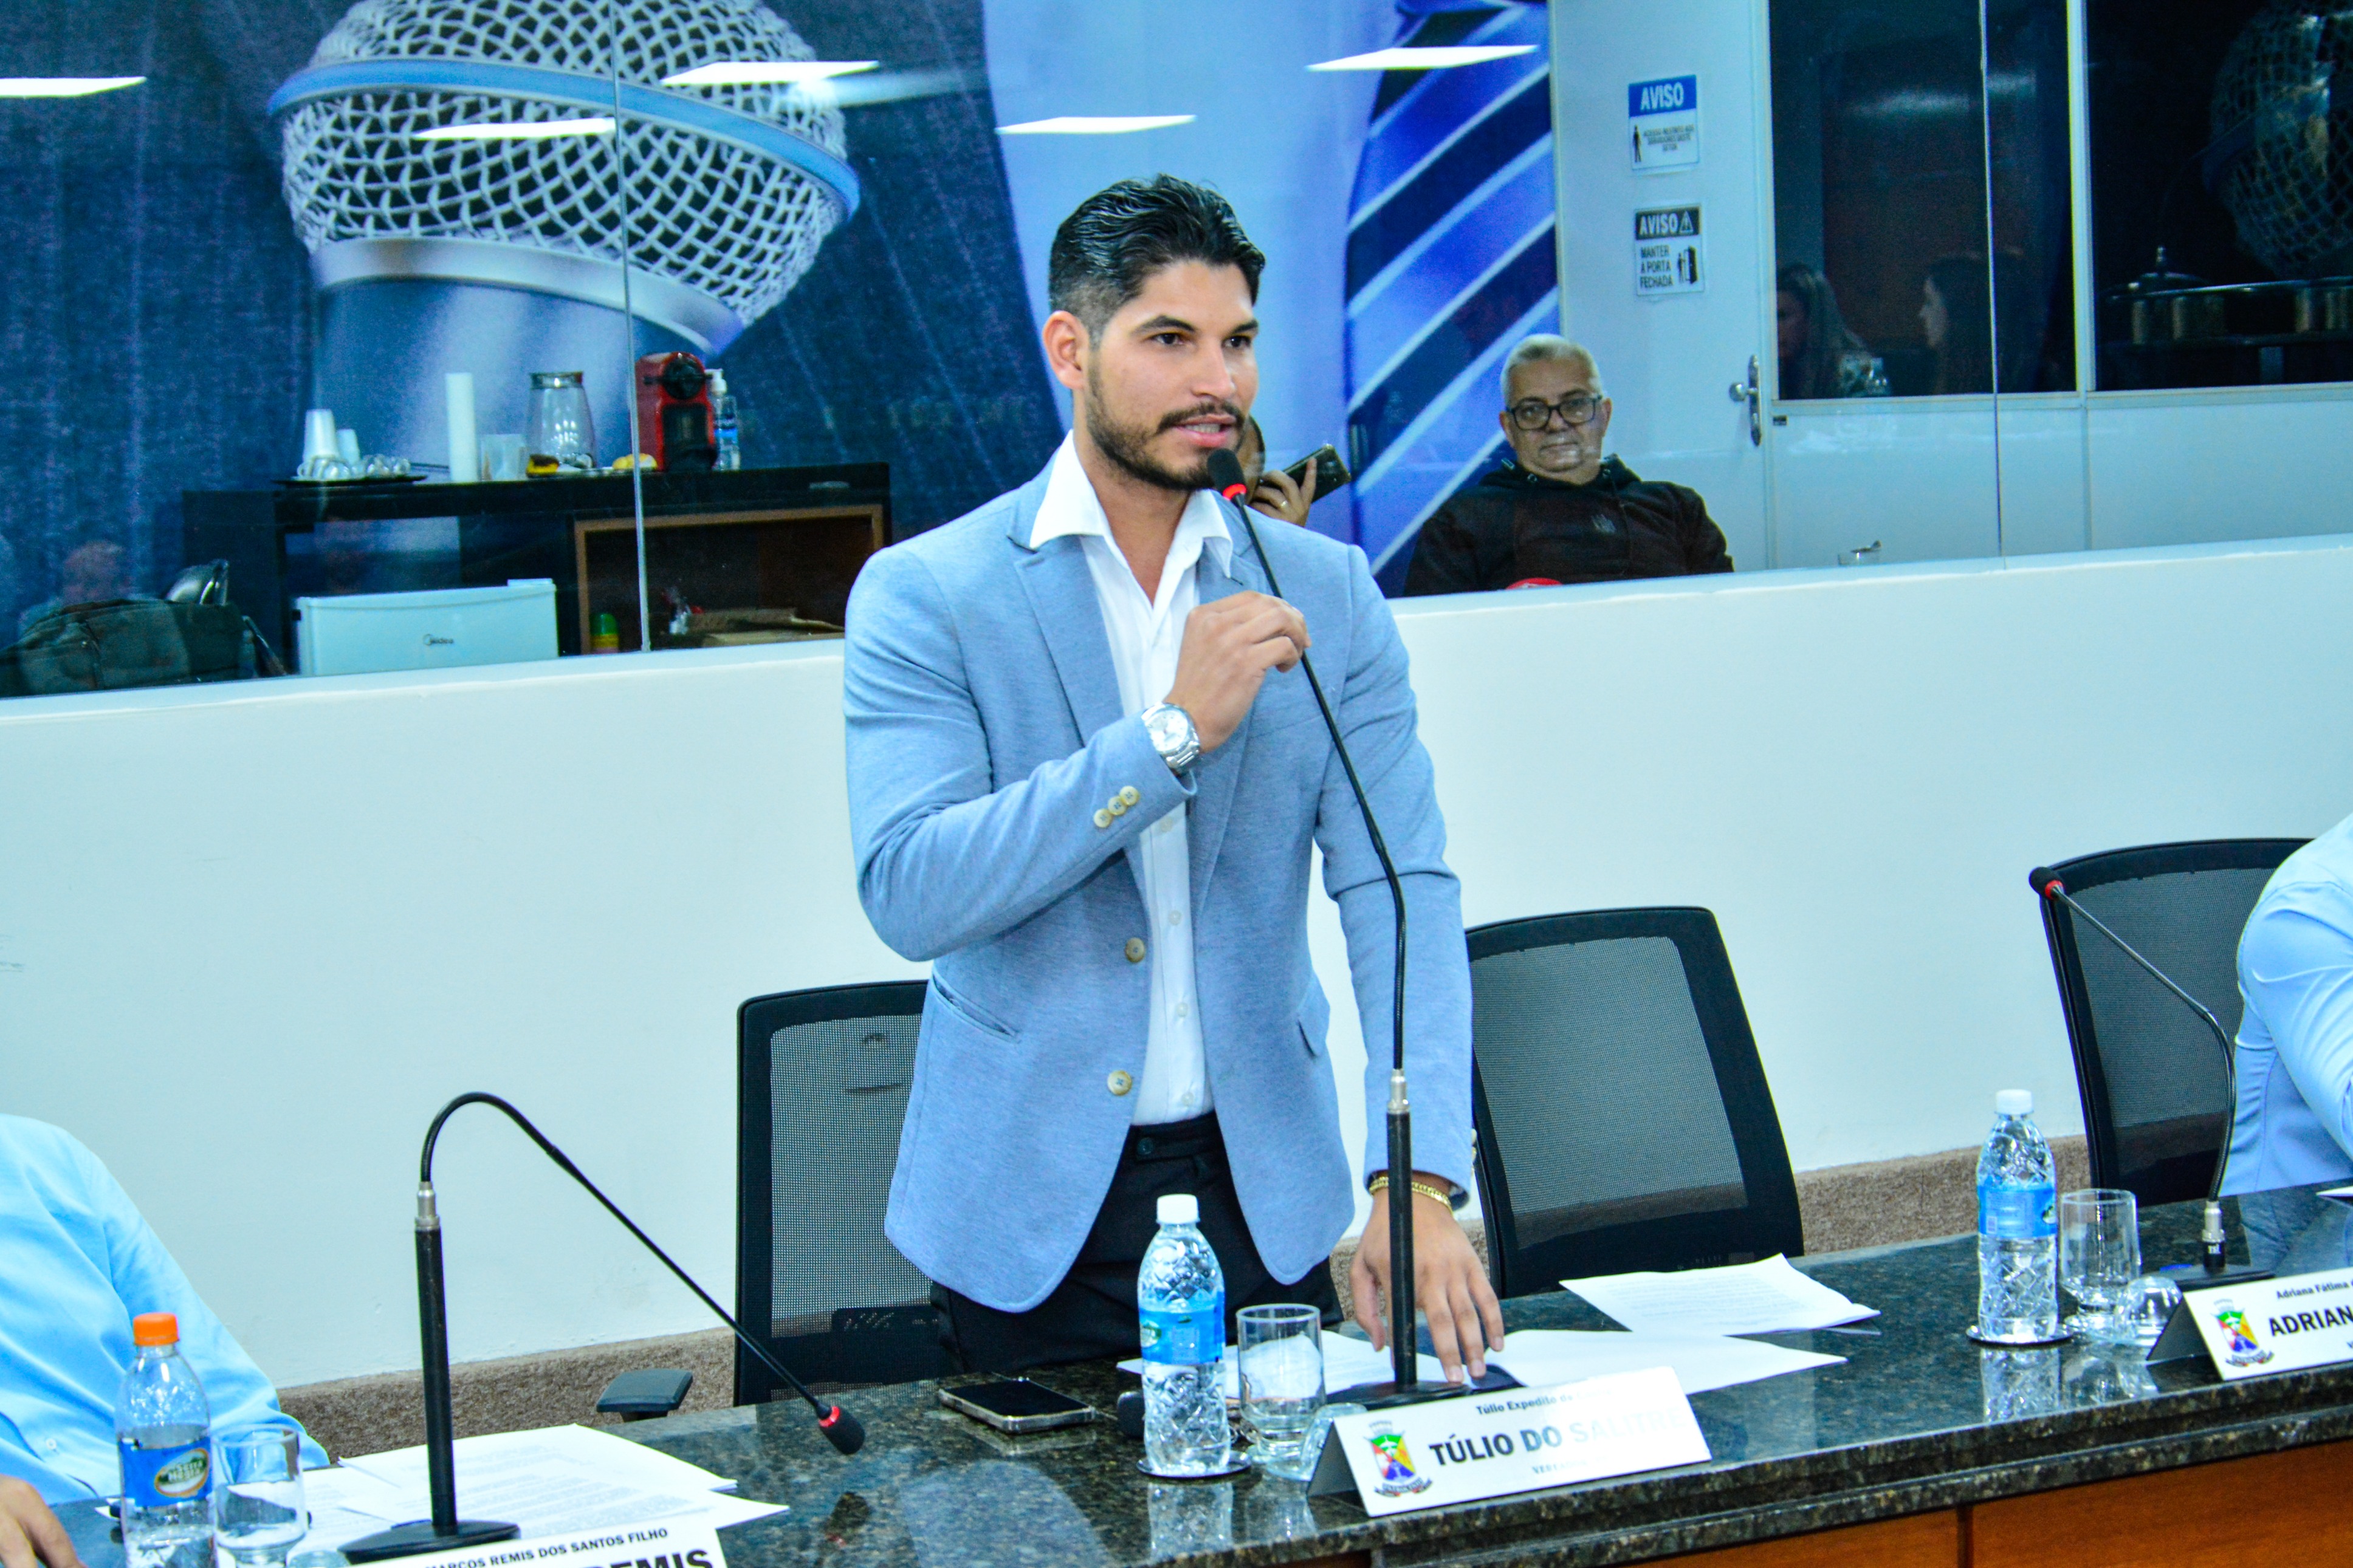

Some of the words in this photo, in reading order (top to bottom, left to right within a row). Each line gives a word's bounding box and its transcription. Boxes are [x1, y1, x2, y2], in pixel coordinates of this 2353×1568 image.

[1641, 81, 1683, 110] AVISO
[1640, 213, 1678, 235] AVISO
[1641, 245, 1670, 258] MANTER
[1641, 262, 1646, 273] A
[1647, 260, 1671, 272] PORTA
[1640, 275, 1674, 288] FECHADA
[2276, 1288, 2314, 1299] Adriana
[2269, 1305, 2353, 1337] ADRIAN
[1475, 1403, 1505, 1415] Túlio
[1507, 1394, 1557, 1411] Expedito
[1429, 1433, 1515, 1467] TÚLIO
[1519, 1425, 1562, 1453] DO
[1568, 1405, 1688, 1443] SALITRE
[490, 1548, 535, 1566] REMIS
[538, 1544, 568, 1558] DOS
[570, 1534, 625, 1553] SANTOS
[628, 1527, 668, 1543] FILHO
